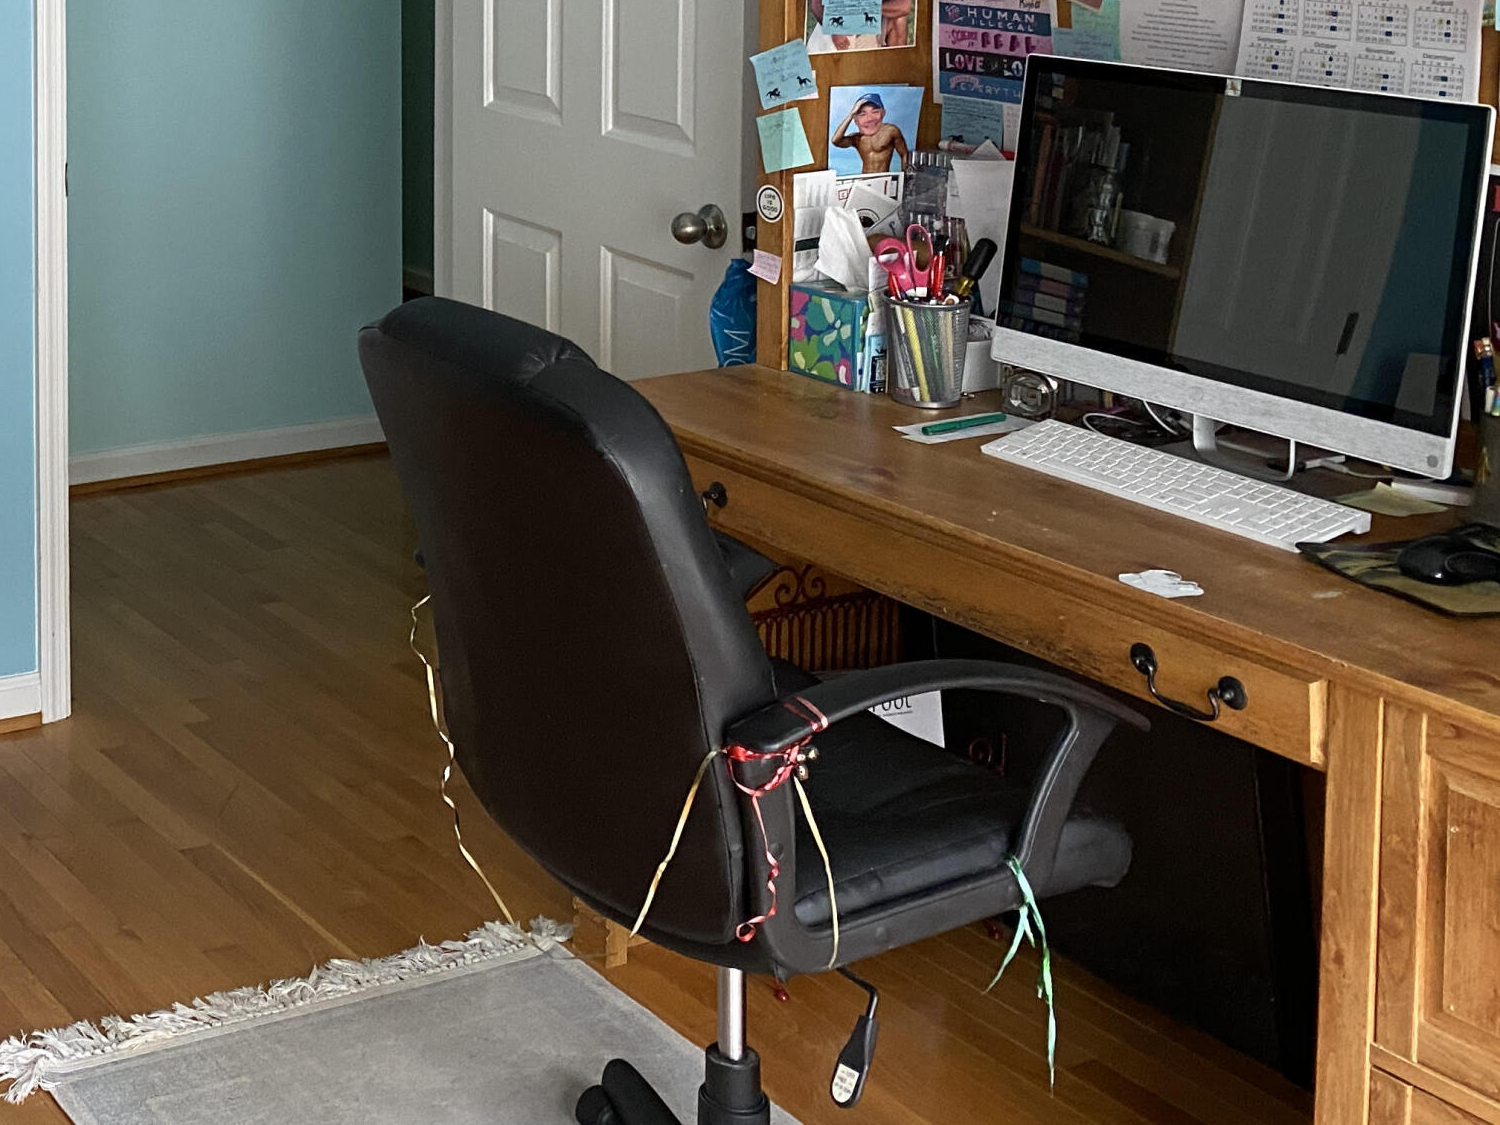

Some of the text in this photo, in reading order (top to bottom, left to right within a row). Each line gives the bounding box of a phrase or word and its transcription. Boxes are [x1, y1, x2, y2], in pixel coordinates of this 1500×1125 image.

[967, 7, 1035, 23] HUMAN
[971, 18, 1034, 32] ILLEGAL
[981, 32, 1036, 54] REAL
[945, 52, 985, 73] LOVE
